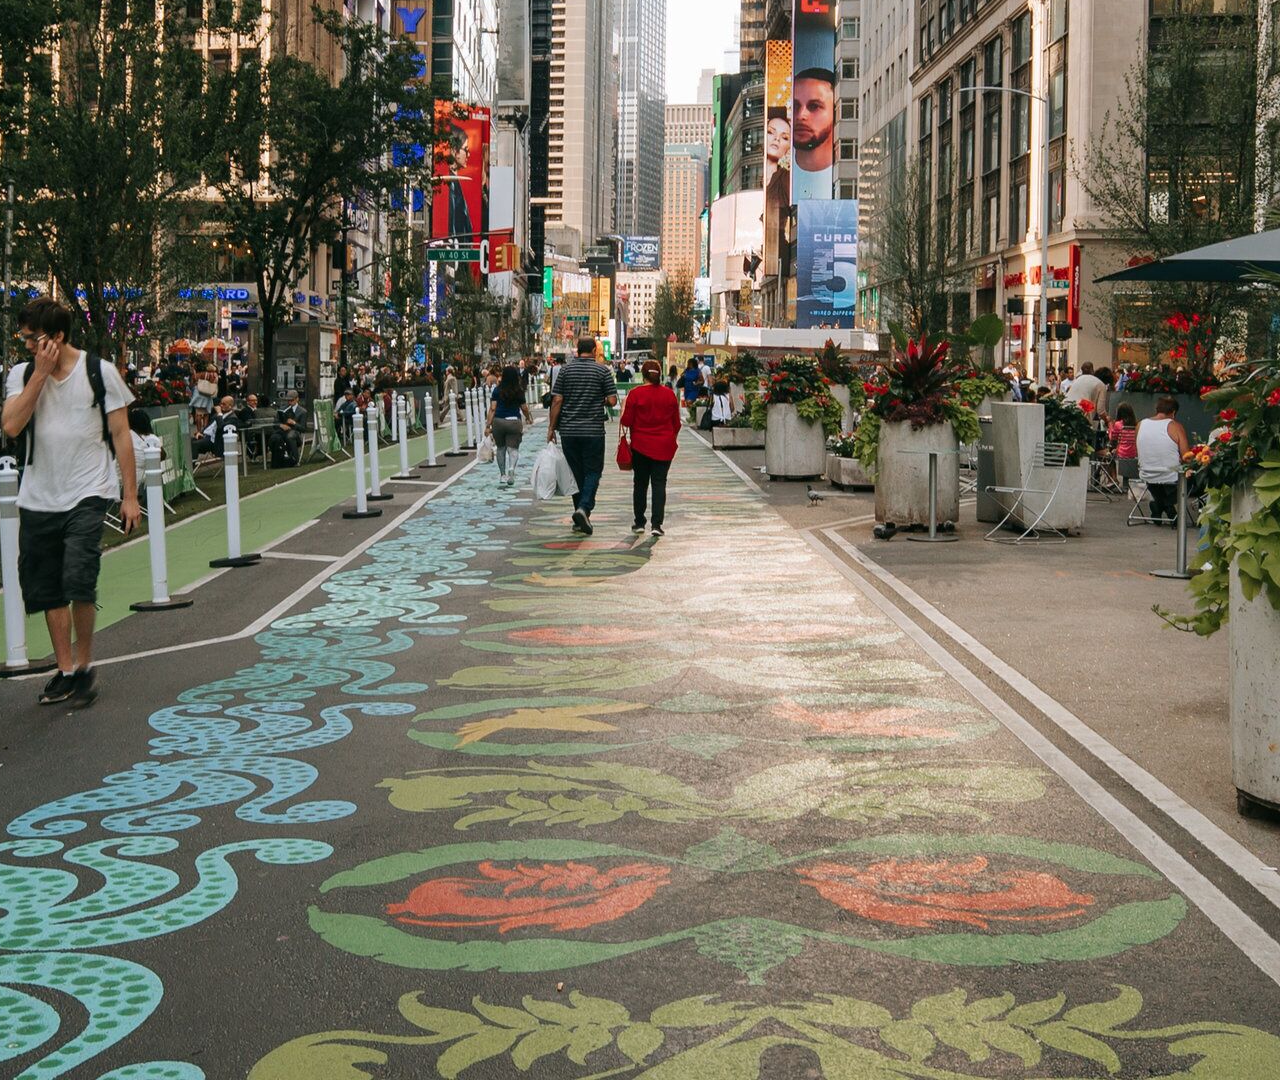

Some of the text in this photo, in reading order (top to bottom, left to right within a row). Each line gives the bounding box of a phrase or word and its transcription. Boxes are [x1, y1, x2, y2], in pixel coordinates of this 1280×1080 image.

[626, 241, 658, 254] FROZEN
[438, 251, 446, 259] W
[448, 251, 459, 259] 40
